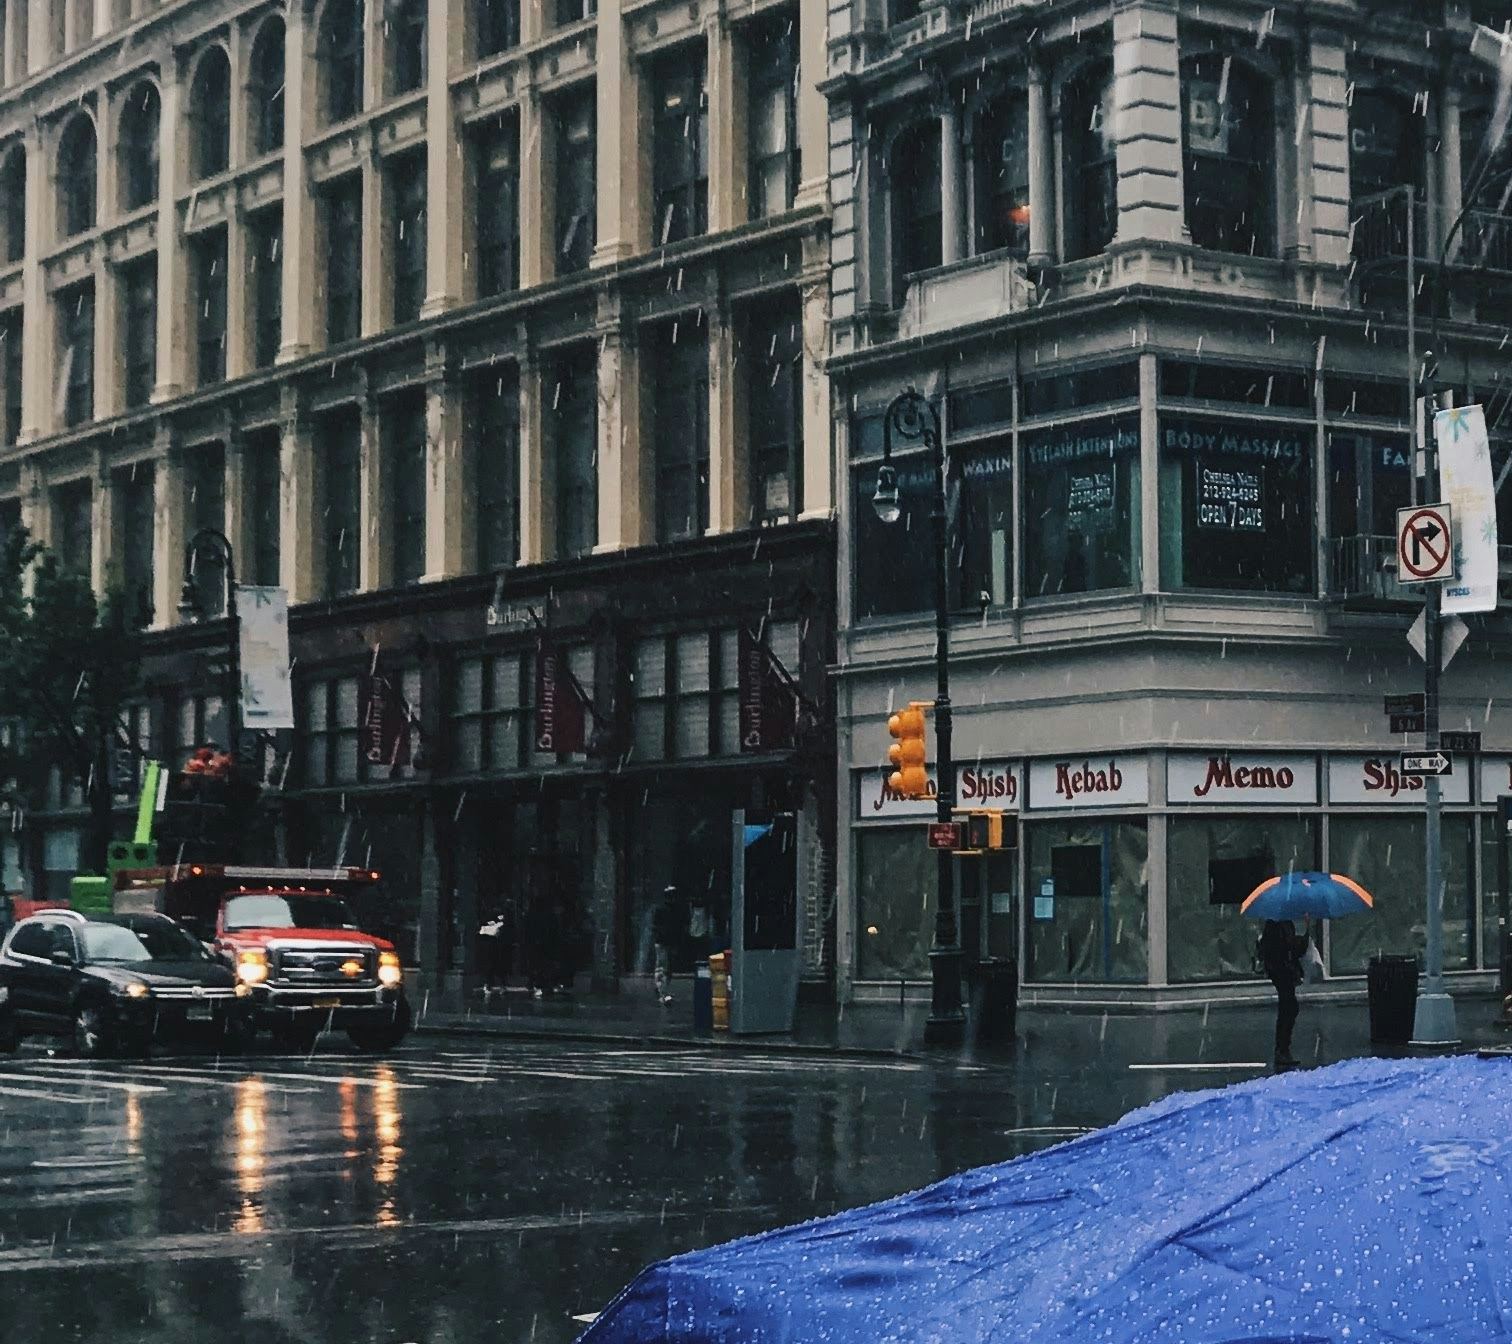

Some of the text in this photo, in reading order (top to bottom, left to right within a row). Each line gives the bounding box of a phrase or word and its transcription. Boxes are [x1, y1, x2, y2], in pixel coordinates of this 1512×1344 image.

[1165, 429, 1302, 457] BODY MASSAGE
[1201, 501, 1262, 527] OPEN 7 DAYS
[539, 655, 557, 748] Burlington
[1194, 757, 1294, 796] Memo
[1363, 759, 1427, 797] Shis
[1407, 759, 1444, 768] ONE WAY
[962, 767, 1017, 804] Shish
[1055, 760, 1123, 799] Kebab
